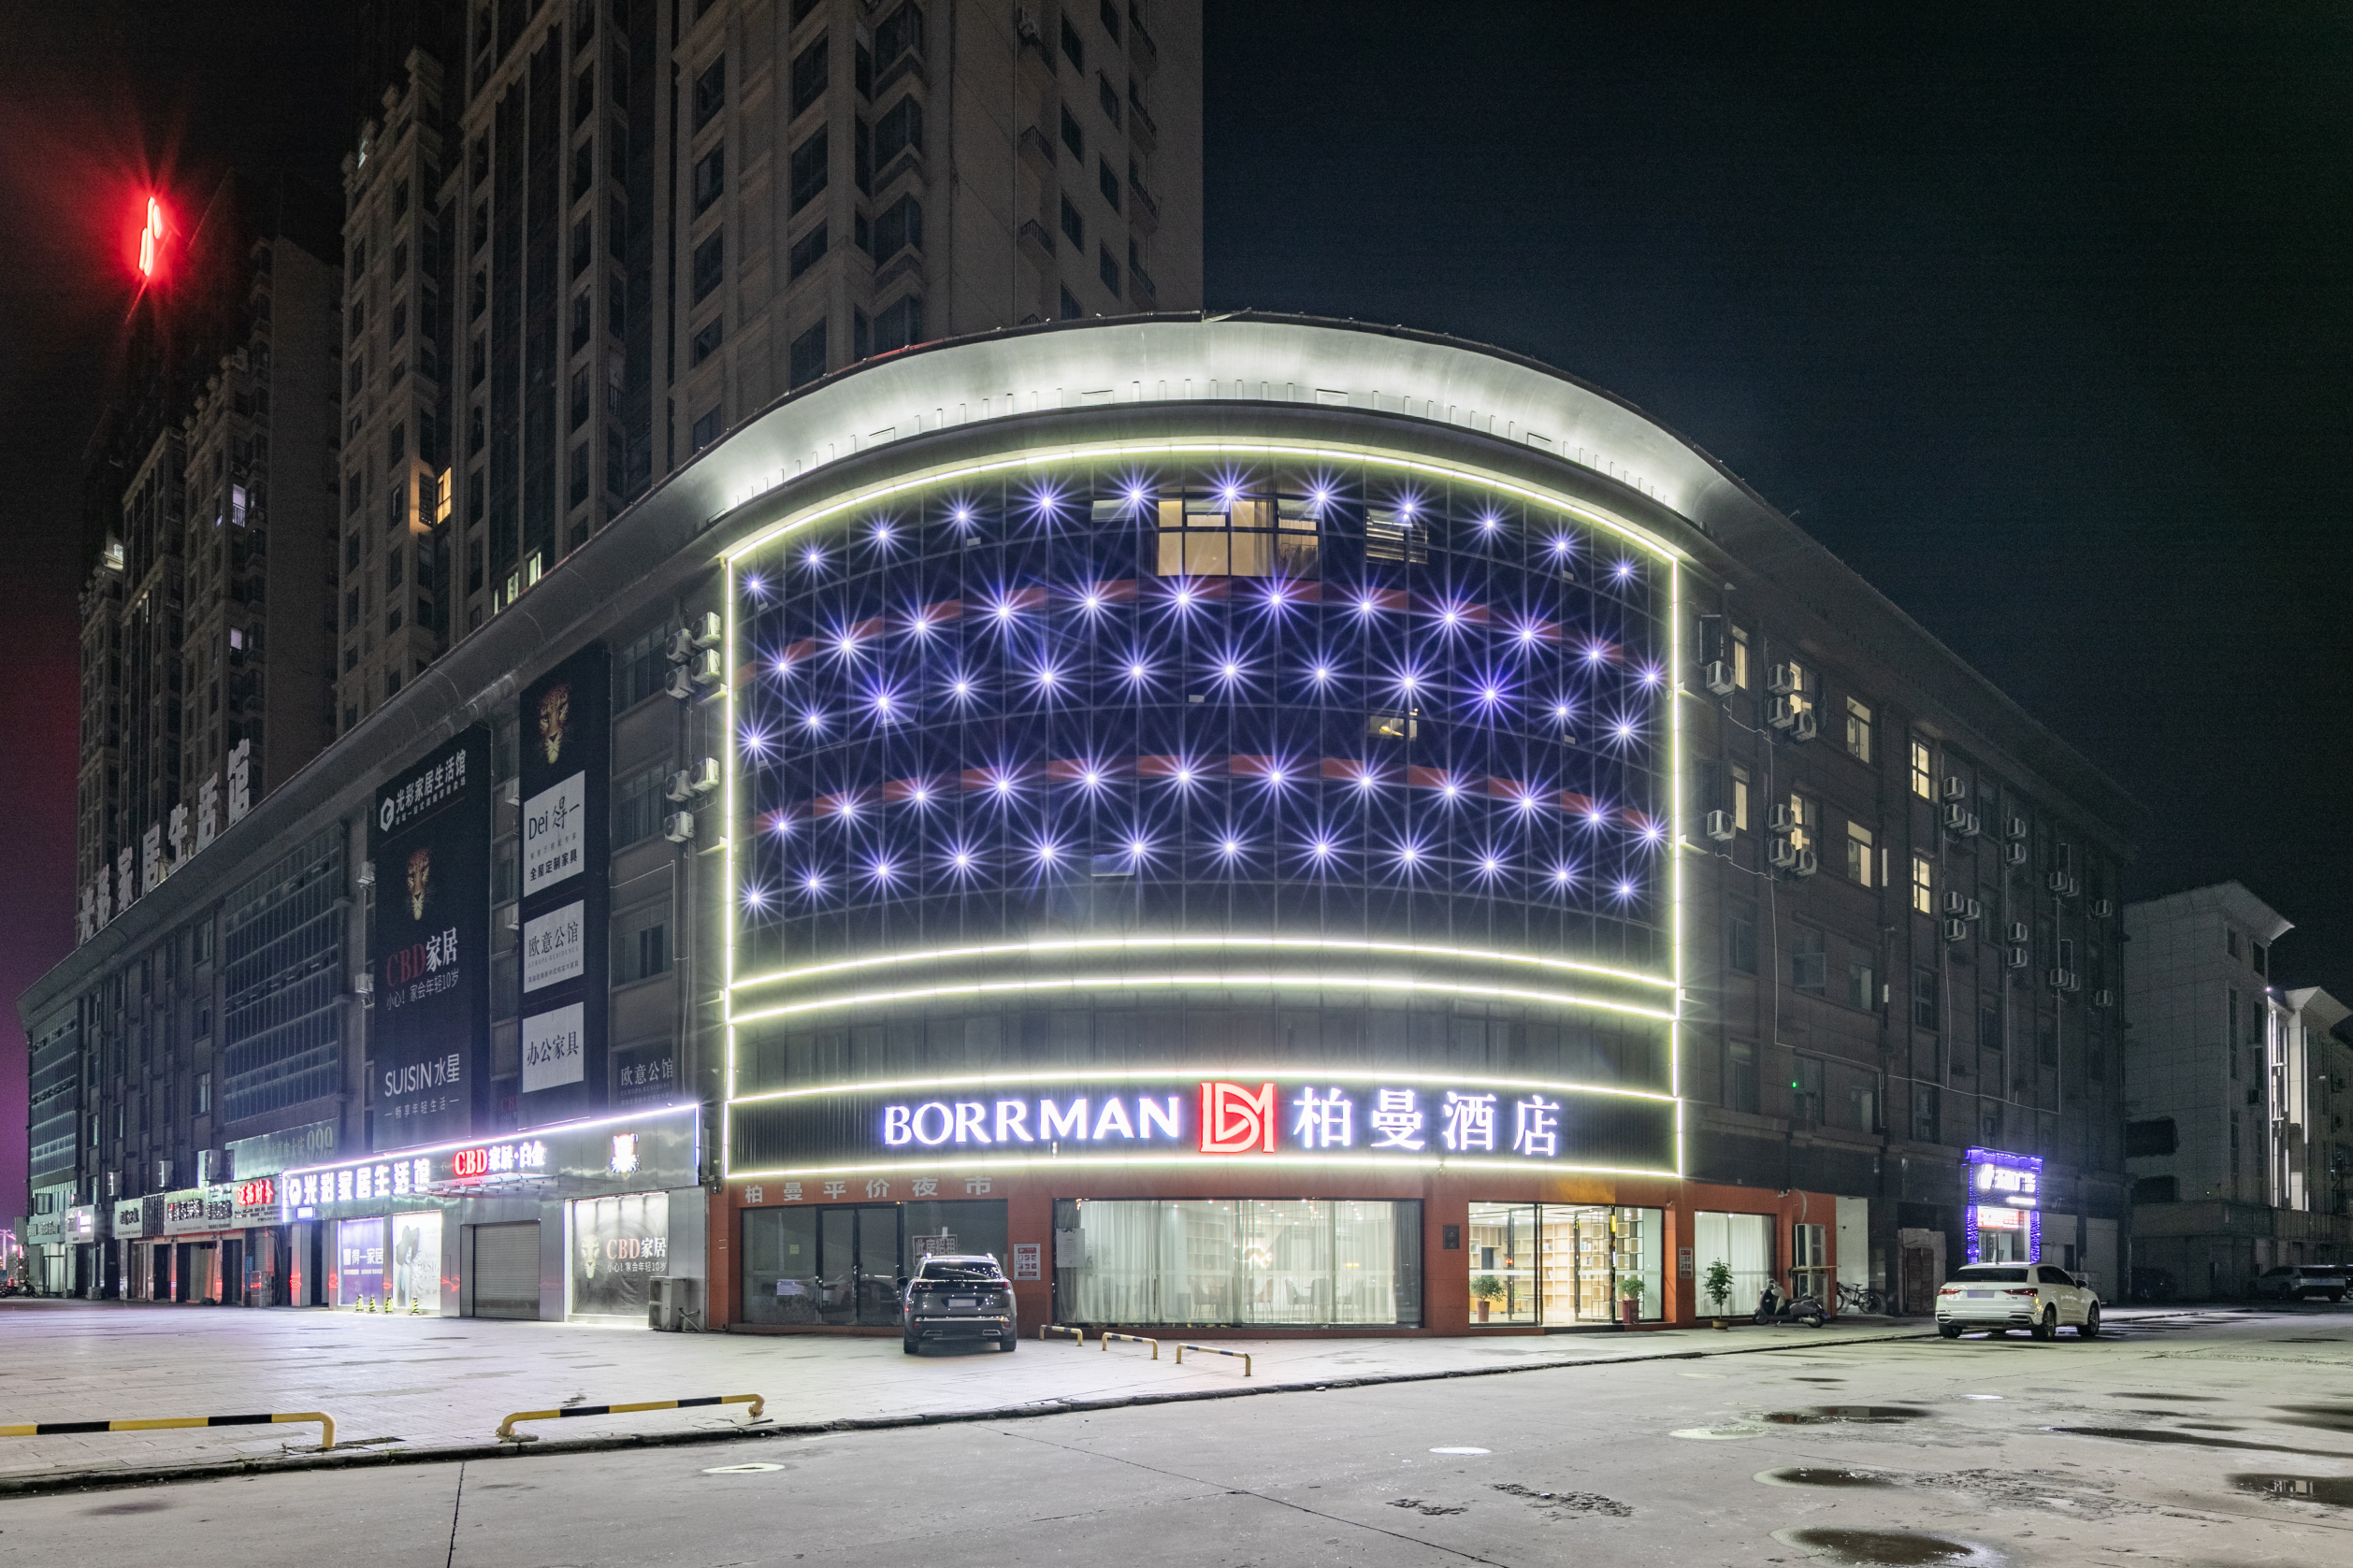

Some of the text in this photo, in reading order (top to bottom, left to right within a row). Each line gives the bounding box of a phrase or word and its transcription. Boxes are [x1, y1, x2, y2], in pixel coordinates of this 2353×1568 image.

[396, 748, 466, 814] 光彩家居生活馆
[528, 810, 548, 841] Dei
[530, 848, 577, 881] 全屋定制家具
[528, 921, 579, 957] 欧意公馆
[527, 1030, 580, 1067] 办公家具
[384, 1053, 460, 1098] SUISIN 水星
[621, 1057, 673, 1086] 欧意公馆
[883, 1096, 1180, 1146] BORRMAN
[1292, 1086, 1560, 1157] 柏曼酒店
[745, 1175, 992, 1203] 柏曼平价夜市
[351, 1247, 384, 1266] 得一家居
[606, 1236, 667, 1259] CBD家居
[915, 1237, 957, 1256] 此房招租
